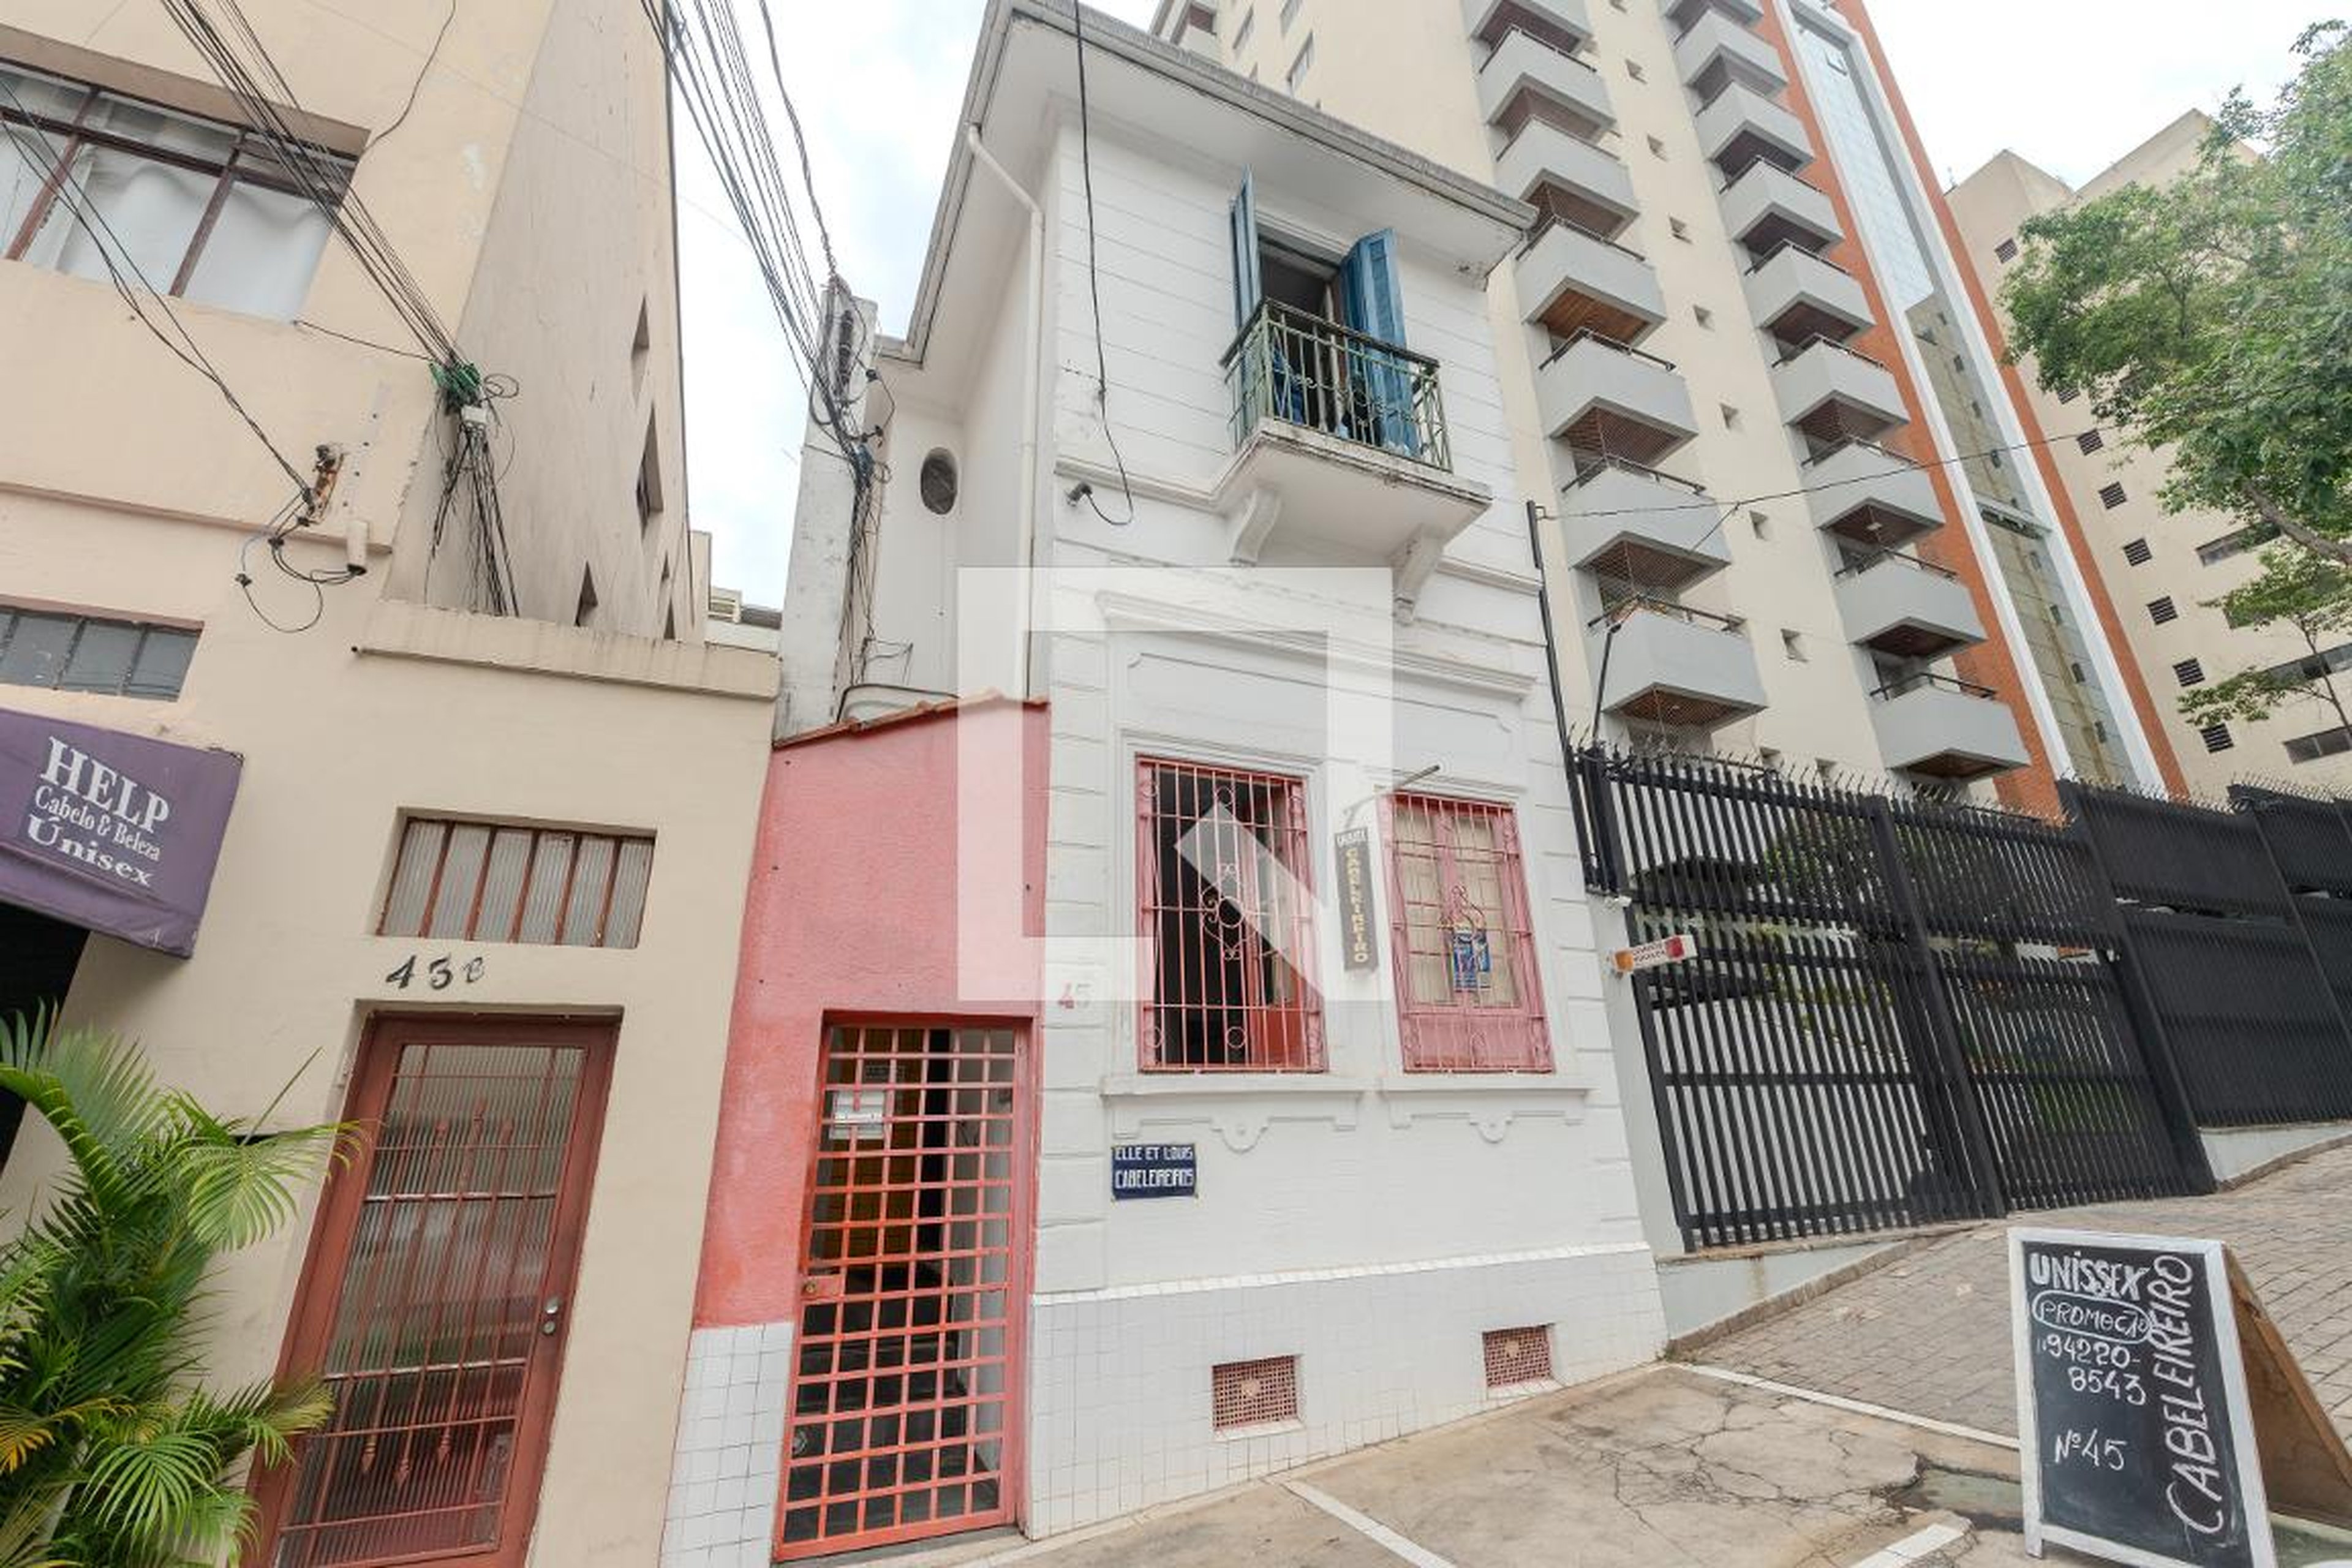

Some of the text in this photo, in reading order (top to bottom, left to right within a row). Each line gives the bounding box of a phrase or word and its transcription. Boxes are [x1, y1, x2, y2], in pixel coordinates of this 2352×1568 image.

[40, 736, 170, 834] HELP
[28, 813, 156, 888] Unisex
[34, 785, 161, 862] Cabelo & Beleza
[1115, 1147, 1142, 1161] ELLE
[1145, 1147, 1160, 1161] ET
[2030, 1251, 2151, 1301] UNISSEX
[2068, 1366, 2146, 1406] 8543
[2147, 1254, 2223, 1533] CABELEIREIRO
[2082, 1428, 2128, 1471] 45
